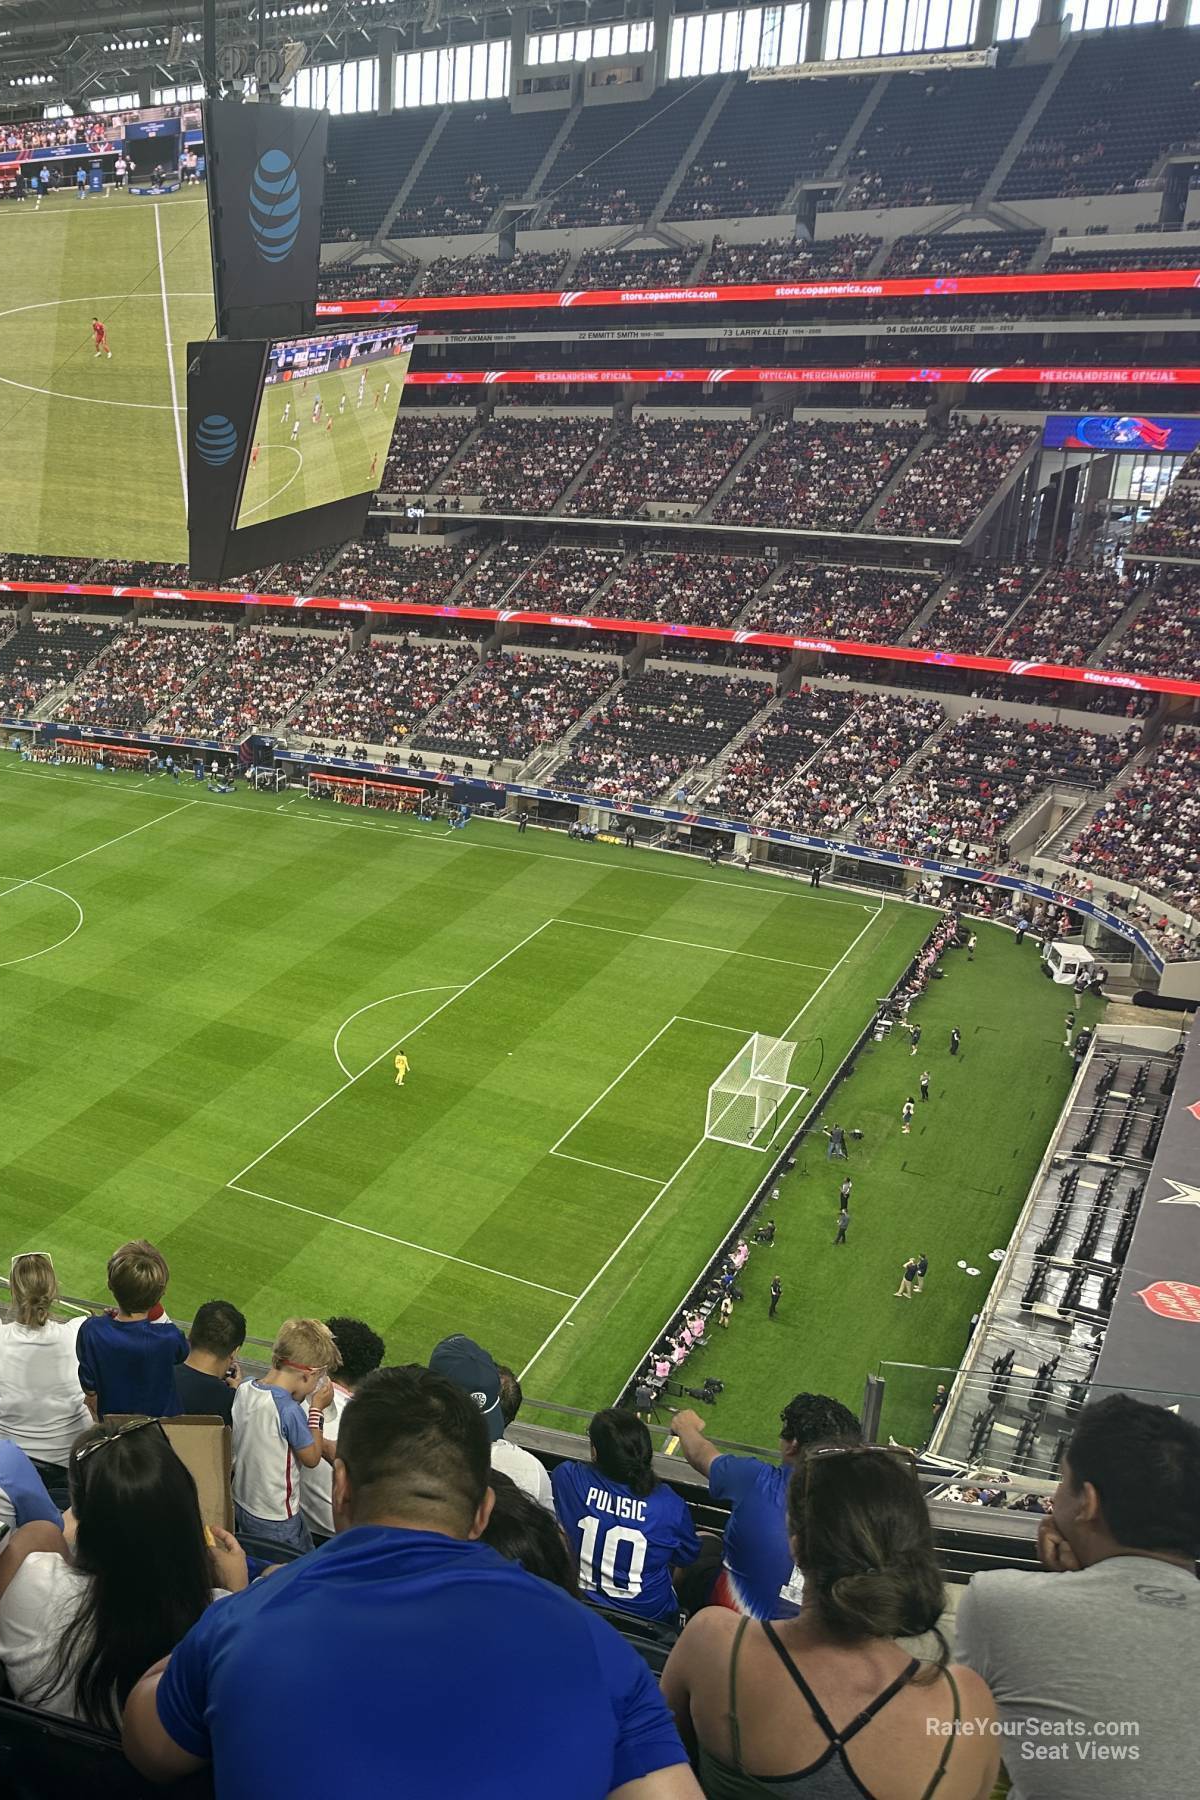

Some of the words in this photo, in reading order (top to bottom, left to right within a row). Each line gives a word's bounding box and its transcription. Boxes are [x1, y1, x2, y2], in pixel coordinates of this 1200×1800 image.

[621, 290, 717, 302] store.copaamerica.com
[775, 284, 883, 298] store.copaamerica.com
[723, 329, 733, 337] 73
[735, 328, 761, 337] LARRY
[762, 328, 789, 336] ALLEN
[949, 324, 976, 333] WARE
[616, 331, 639, 339] SMITH
[758, 371, 799, 380] OFFICIAL
[801, 370, 877, 380] MERCHANDISING
[1040, 371, 1128, 382] MERCHANDISING
[1132, 371, 1177, 382] OFICIAL
[585, 1486, 648, 1522] PULISIC
[577, 1515, 648, 1599] 10
